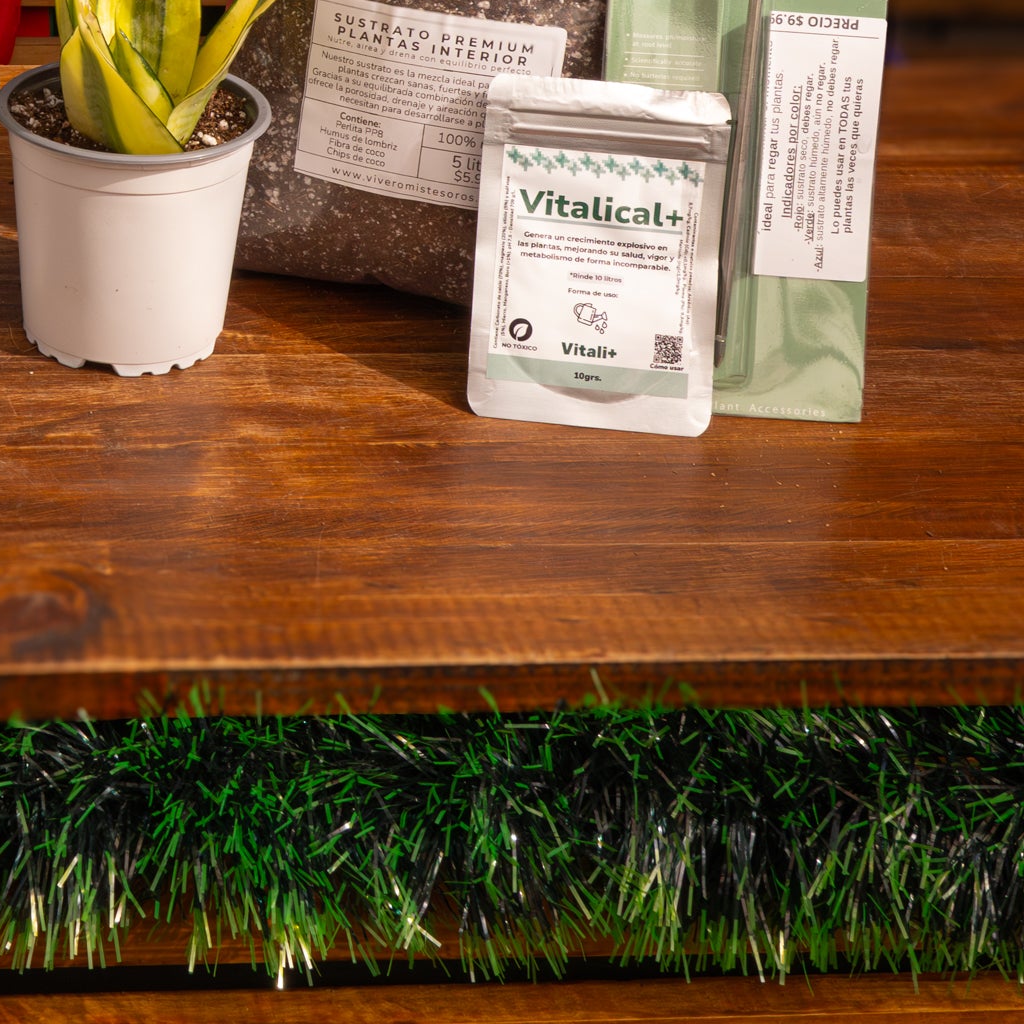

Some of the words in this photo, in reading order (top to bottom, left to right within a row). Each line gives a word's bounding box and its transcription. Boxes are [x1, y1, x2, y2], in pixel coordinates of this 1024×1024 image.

[334, 12, 430, 40] SUSTRATO
[441, 33, 534, 54] PREMIUM
[808, 15, 859, 31] PRECIO
[337, 25, 420, 51] PLANTAS
[431, 44, 527, 66] INTERIOR
[356, 42, 378, 53] airea
[389, 49, 416, 60] drena
[419, 55, 436, 63] con
[439, 57, 487, 71] equilibrio
[490, 65, 531, 76] perfecto
[831, 36, 840, 65] regar.
[321, 50, 355, 65] Nuestro
[356, 59, 392, 74] sustrato
[394, 68, 405, 76] es
[407, 69, 415, 78] la
[417, 72, 450, 84] mezcla
[452, 77, 475, 88] ideal
[477, 82, 489, 90] pa
[338, 65, 369, 79] plantas
[371, 75, 405, 86] crezcan
[407, 79, 436, 92] sanas,
[438, 84, 472, 97] fuertes
[474, 91, 480, 99] y
[817, 62, 827, 90] regar.
[827, 67, 836, 97] debes
[308, 78, 333, 89] ofrece
[336, 83, 343, 91] la
[345, 86, 389, 103] porosidad,
[392, 96, 426, 111] drenaje
[428, 104, 434, 112] y
[436, 105, 478, 117] aireación
[312, 67, 343, 81] Gracias
[351, 78, 361, 86] su
[363, 82, 413, 96] equilibrada
[415, 91, 474, 107] combinación
[805, 73, 815, 102] regar.
[843, 76, 852, 93] tus
[853, 78, 864, 118] quieras
[339, 95, 380, 110] necesitan
[381, 105, 402, 115] para
[404, 108, 465, 126] desarrollarse
[789, 84, 802, 120] color:
[816, 93, 823, 105] no
[826, 100, 834, 112] no
[336, 120, 363, 134] Perlita
[339, 111, 382, 129] Contiene:
[770, 117, 780, 134] tus
[801, 104, 811, 134] debes
[813, 108, 822, 125] aún
[838, 95, 850, 134] TODAS
[319, 125, 350, 140] Humus
[351, 134, 363, 143] de
[364, 137, 398, 151] lombriz
[437, 131, 477, 148] 100%
[788, 123, 799, 144] por
[839, 137, 846, 150] en
[851, 120, 861, 140] que
[326, 146, 351, 160] Chips
[352, 153, 364, 162] de
[365, 157, 386, 167] coco
[328, 137, 351, 150] Fibra
[352, 144, 363, 153] de
[365, 148, 386, 158] coco
[768, 137, 780, 170] regar
[800, 136, 809, 161] seco,
[809, 128, 821, 168] húmedo,
[848, 143, 858, 174] veces
[451, 155, 462, 169] 5
[466, 157, 482, 172] lit
[453, 169, 480, 184] $5.9
[836, 152, 845, 176] usar
[331, 167, 478, 202] www.viveromistesoros.
[765, 173, 776, 199] para
[781, 147, 797, 219] Indicadores
[796, 163, 806, 200] sustrato
[807, 170, 817, 207] sustrato
[818, 156, 828, 202] altamente
[845, 176, 855, 192] las
[519, 188, 684, 227] Vitalical+
[833, 178, 843, 218] puedes
[761, 202, 774, 232] ideal
[794, 202, 805, 232] -Rojo:
[804, 209, 815, 245] -Verde:
[816, 204, 825, 241] sustrato
[831, 220, 840, 234] Lo
[842, 195, 854, 234] plantas
[523, 231, 552, 241] Genera
[566, 235, 616, 247] crecimiento
[616, 241, 656, 251] explosivo
[530, 241, 562, 252] plantas,
[564, 244, 608, 257] mejorando
[621, 250, 645, 260] salud,
[647, 253, 669, 263] vigor
[520, 249, 573, 262] metabolismo
[574, 255, 585, 263] de
[586, 256, 611, 266] forma
[612, 258, 671, 272] incomparable.
[814, 243, 824, 272] -Azul:
[604, 275, 622, 283] litros
[567, 287, 591, 296] Forma
[603, 291, 619, 299] uso:
[512, 342, 538, 352] TÓXICO
[561, 341, 617, 359] Vitali+
[573, 371, 602, 383] 10grs.
[649, 363, 668, 371] Cómo
[714, 399, 740, 411] lant
[748, 403, 826, 418] Accessories
